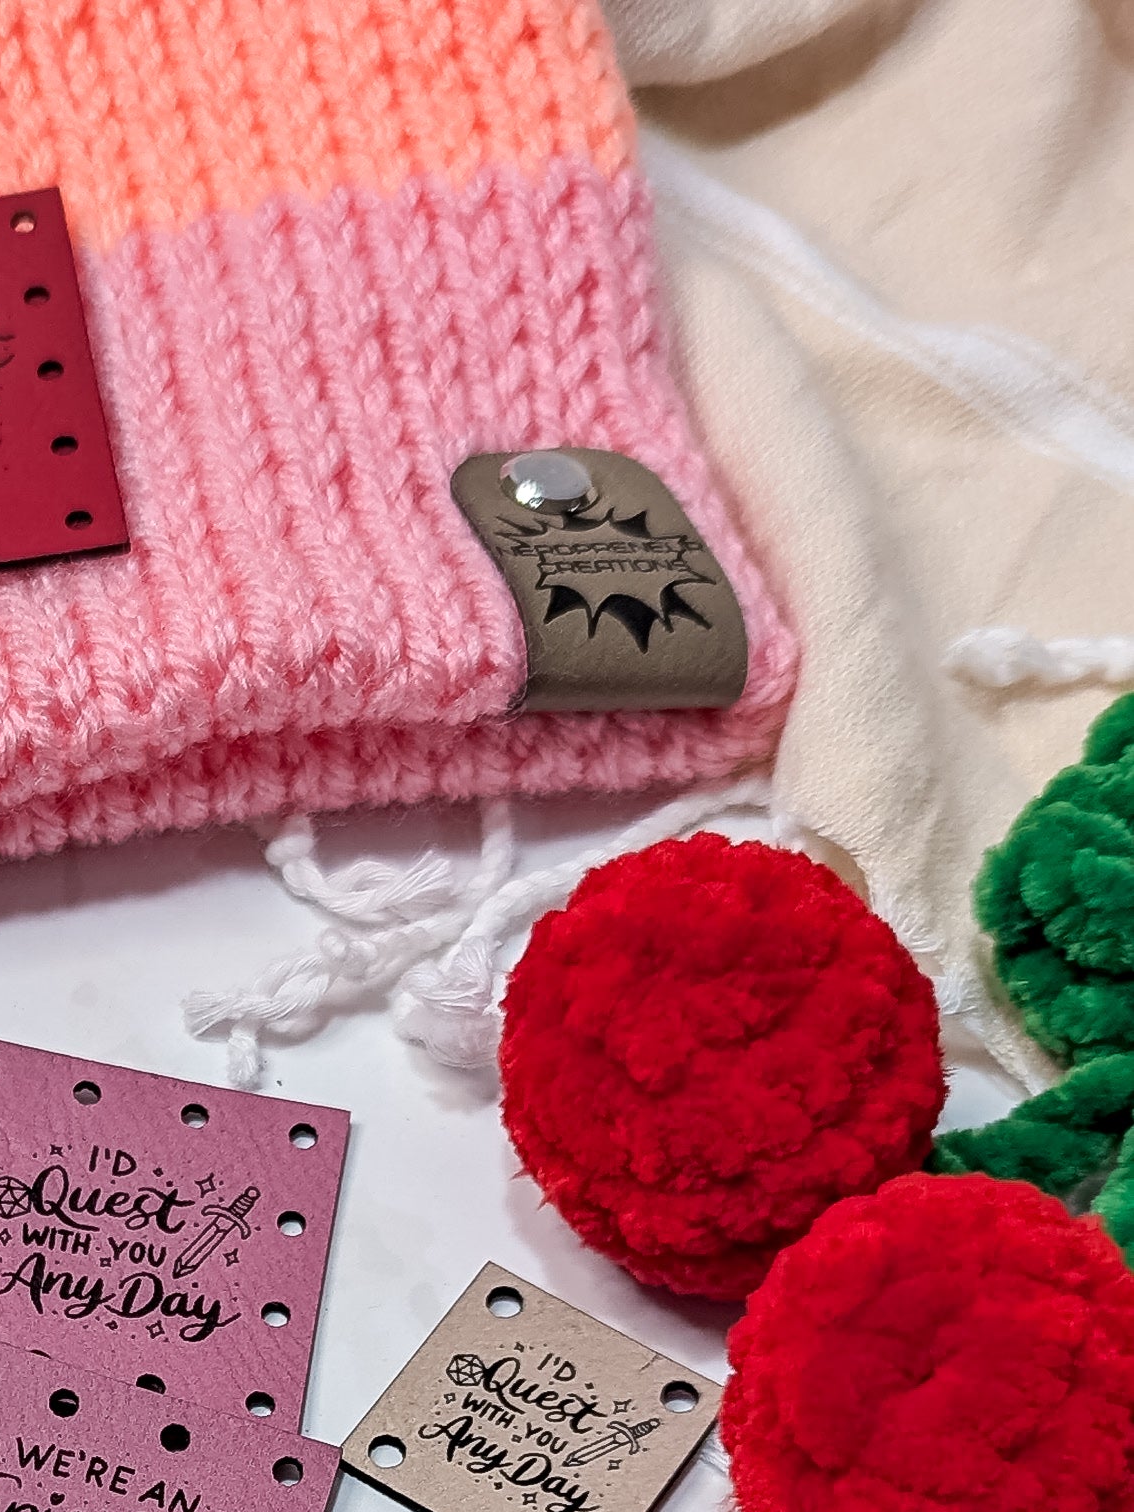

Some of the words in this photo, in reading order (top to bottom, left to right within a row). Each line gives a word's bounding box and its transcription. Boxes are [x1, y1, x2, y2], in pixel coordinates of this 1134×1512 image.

[89, 1145, 137, 1176] I'D
[31, 1165, 195, 1234] Quest
[23, 1222, 91, 1255] WITH
[108, 1237, 166, 1267] YOU
[104, 1272, 241, 1342] Day
[483, 1357, 607, 1434] Quest
[537, 1353, 576, 1382] I'D
[418, 1416, 512, 1473] Any
[461, 1392, 511, 1429] WITH
[525, 1422, 568, 1453] YOU
[16, 1436, 135, 1494] WE'RE
